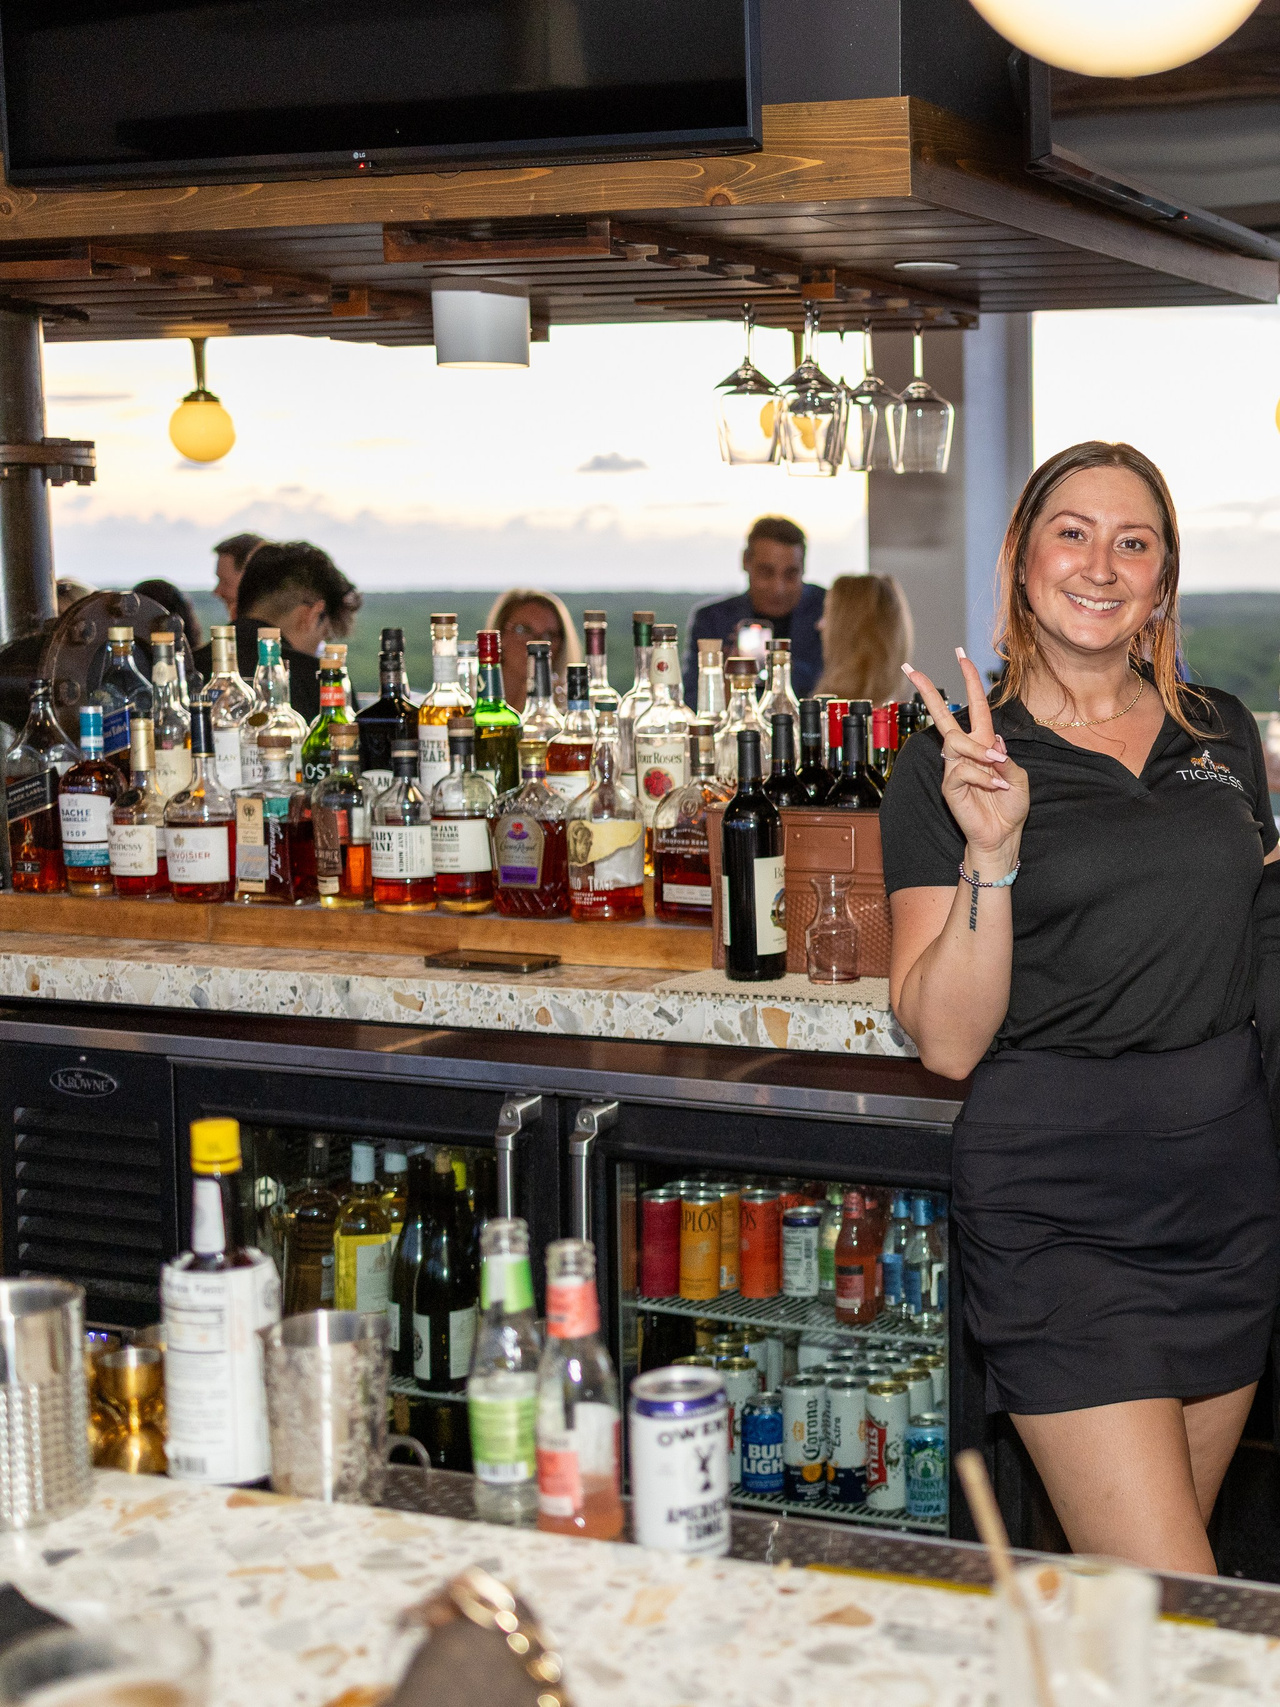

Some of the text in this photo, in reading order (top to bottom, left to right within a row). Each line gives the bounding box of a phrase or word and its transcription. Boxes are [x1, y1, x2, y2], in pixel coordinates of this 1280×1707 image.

[653, 752, 682, 764] Roses
[1175, 769, 1244, 792] TIGRESS
[168, 851, 211, 860] RVOISIER
[24, 863, 32, 871] 12
[58, 1073, 109, 1093] KROWNE
[802, 1395, 820, 1461] Corona
[832, 1416, 841, 1447] Extra
[868, 1427, 879, 1481] STELLA
[743, 1457, 782, 1475] LIGH
[922, 1503, 942, 1512] IPA
